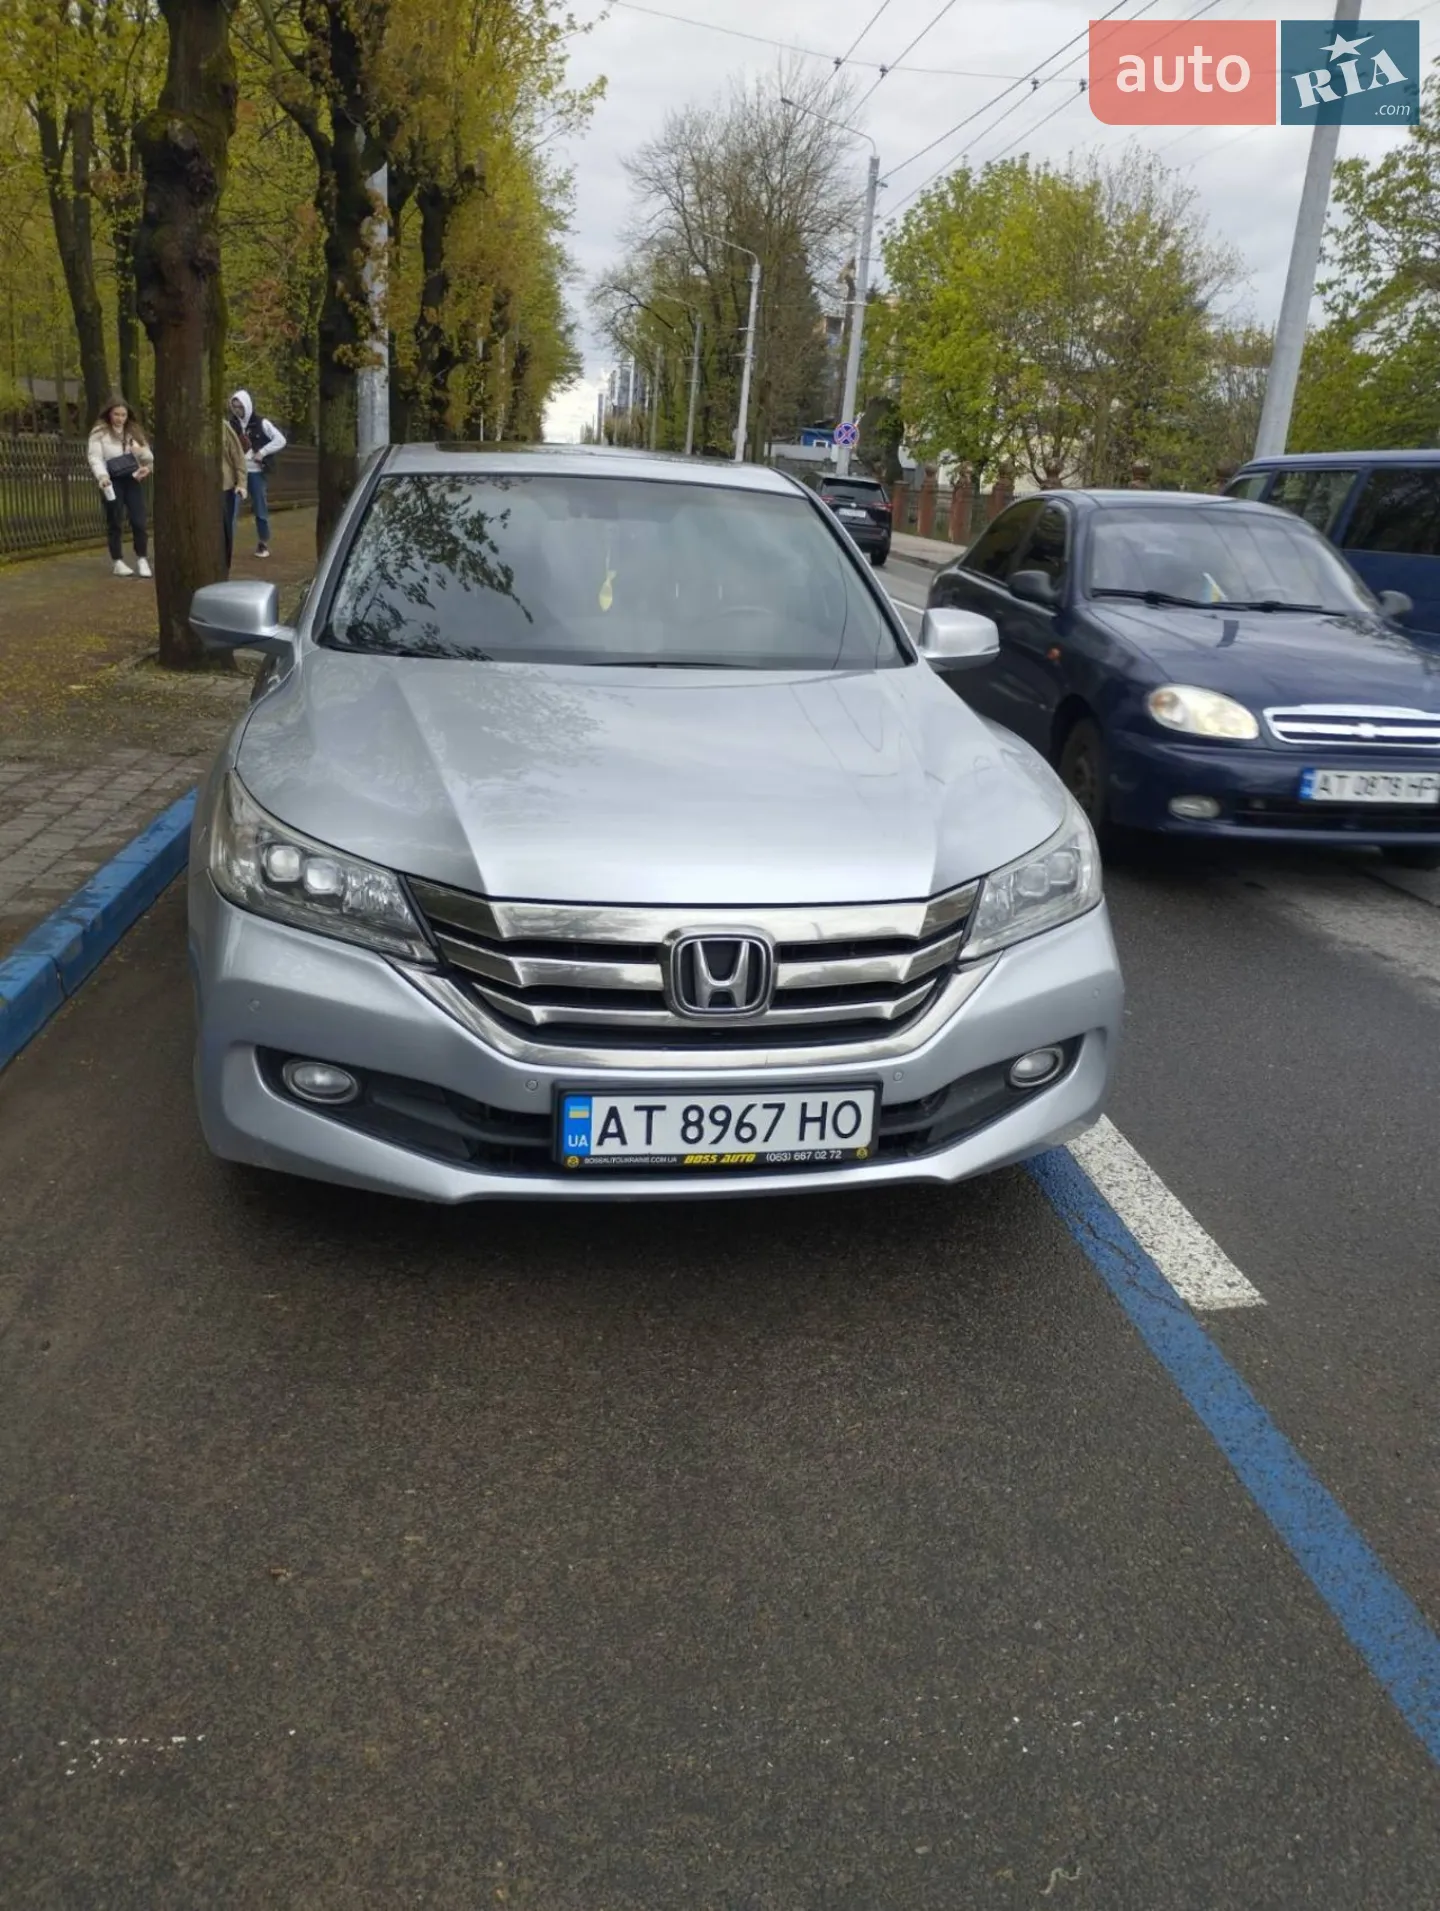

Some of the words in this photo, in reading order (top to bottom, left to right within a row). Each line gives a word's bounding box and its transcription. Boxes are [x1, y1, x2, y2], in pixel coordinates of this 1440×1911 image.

[596, 1104, 667, 1147] AT
[680, 1102, 786, 1146] 8967
[799, 1099, 862, 1142] HO
[568, 1134, 589, 1148] UA
[683, 1154, 718, 1165] BOSS
[720, 1153, 757, 1164] AUTO
[815, 1150, 828, 1160] 02
[829, 1149, 843, 1159] 72
